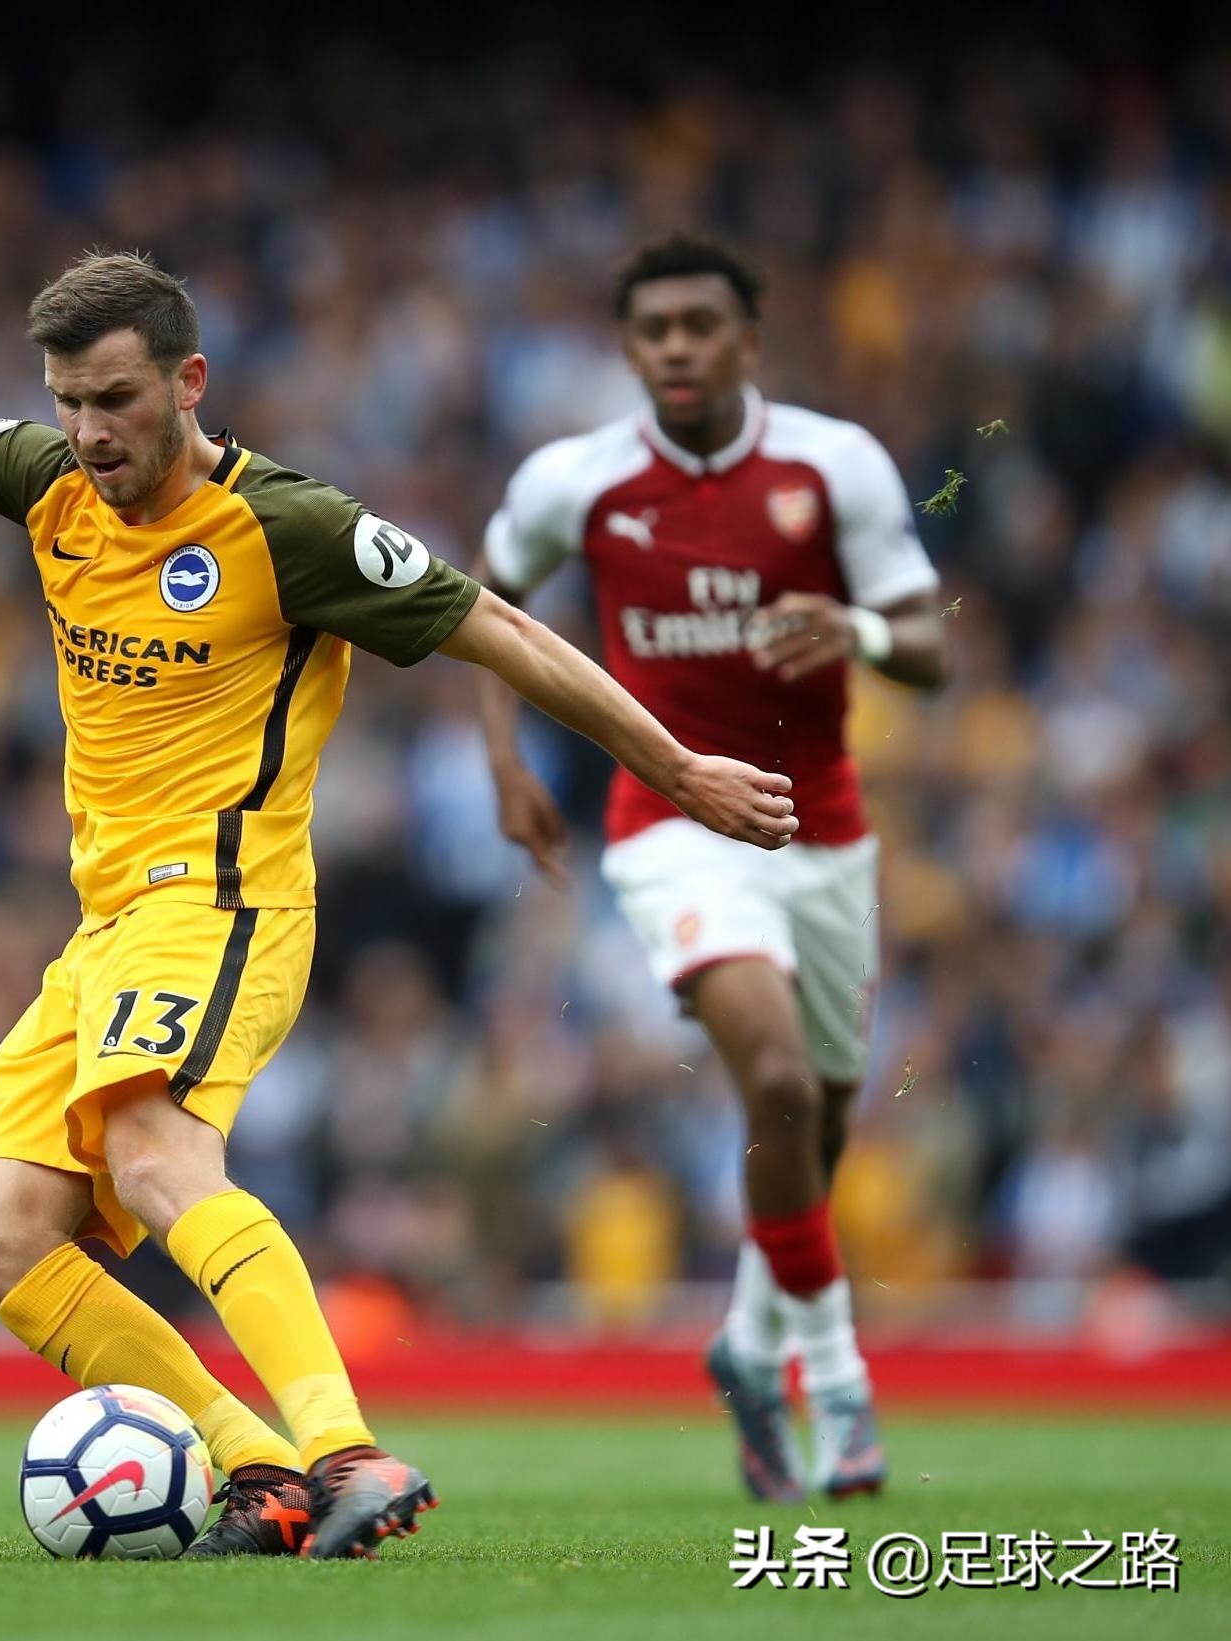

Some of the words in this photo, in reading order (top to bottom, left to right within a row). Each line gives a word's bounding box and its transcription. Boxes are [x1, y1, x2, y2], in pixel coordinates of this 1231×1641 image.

[371, 523, 413, 582] JD
[688, 567, 760, 607] Fly
[57, 638, 159, 688] PRESS
[103, 991, 199, 1055] 13
